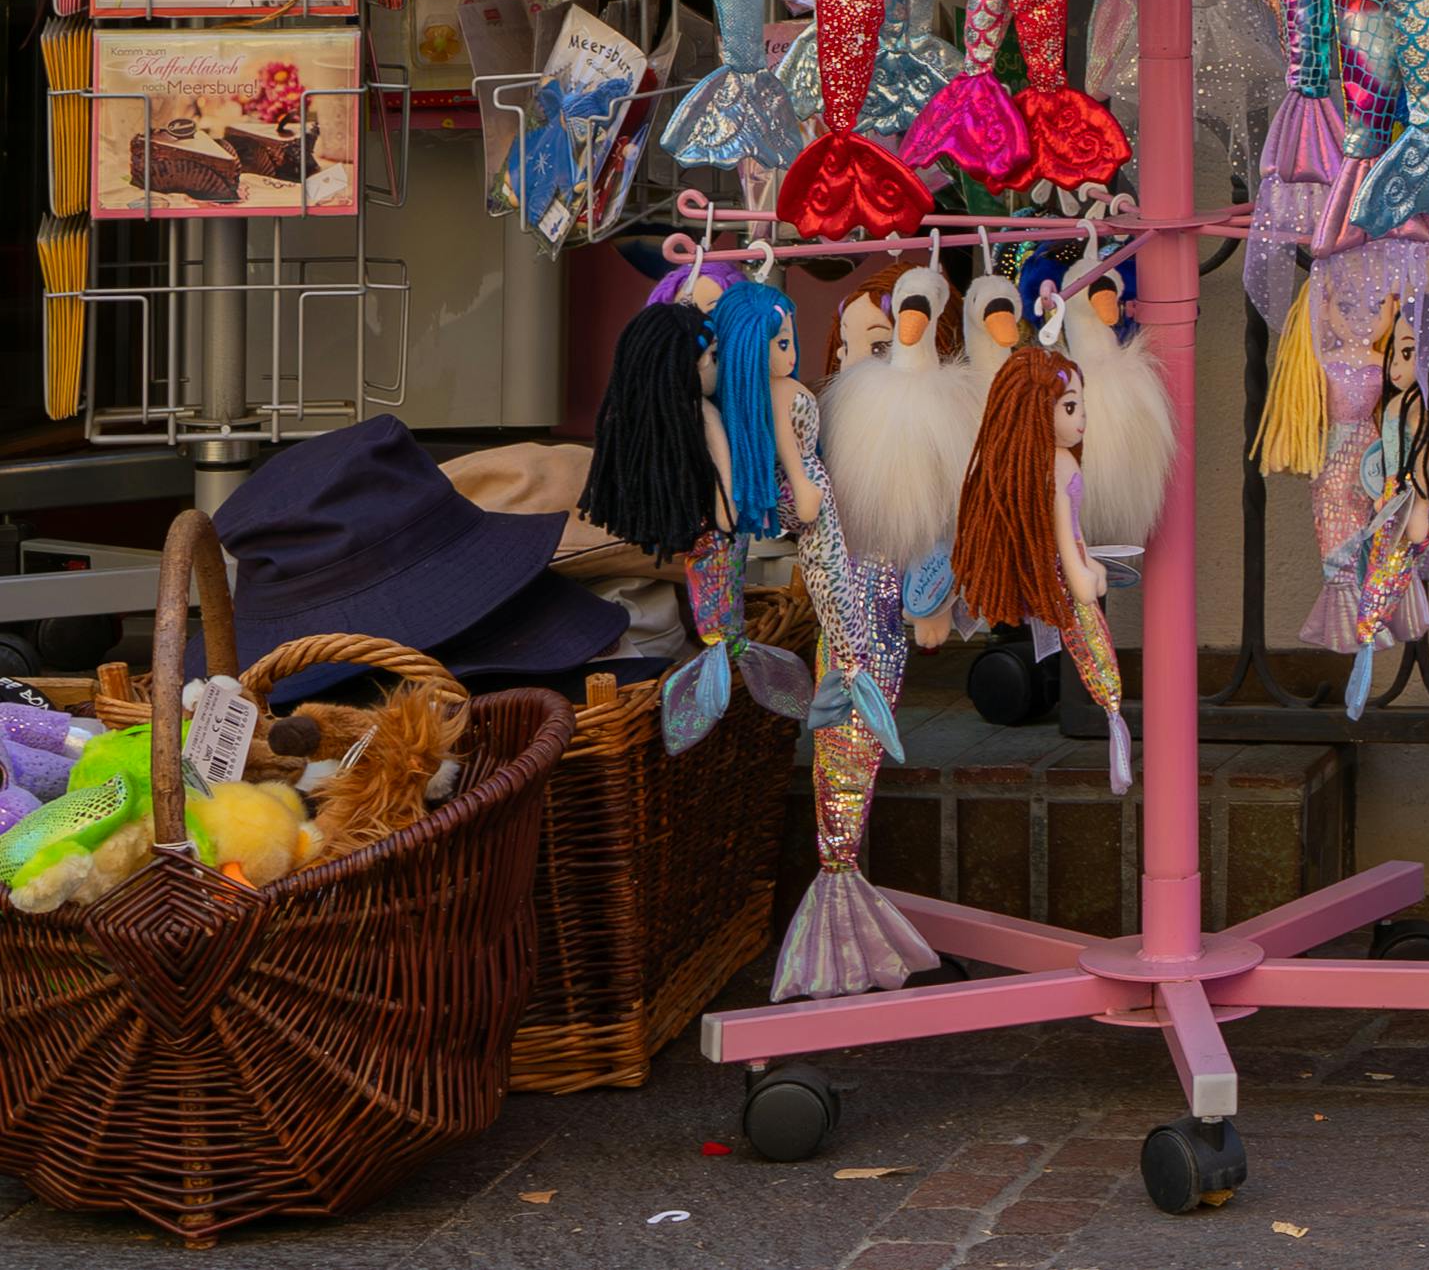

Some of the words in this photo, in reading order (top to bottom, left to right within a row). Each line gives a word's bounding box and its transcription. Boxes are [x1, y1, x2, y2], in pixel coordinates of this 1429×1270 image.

[111, 47, 142, 57] Komm
[145, 48, 167, 57] zum
[128, 54, 245, 80] Kaffeeklatsch
[167, 80, 258, 98] Meersburg!
